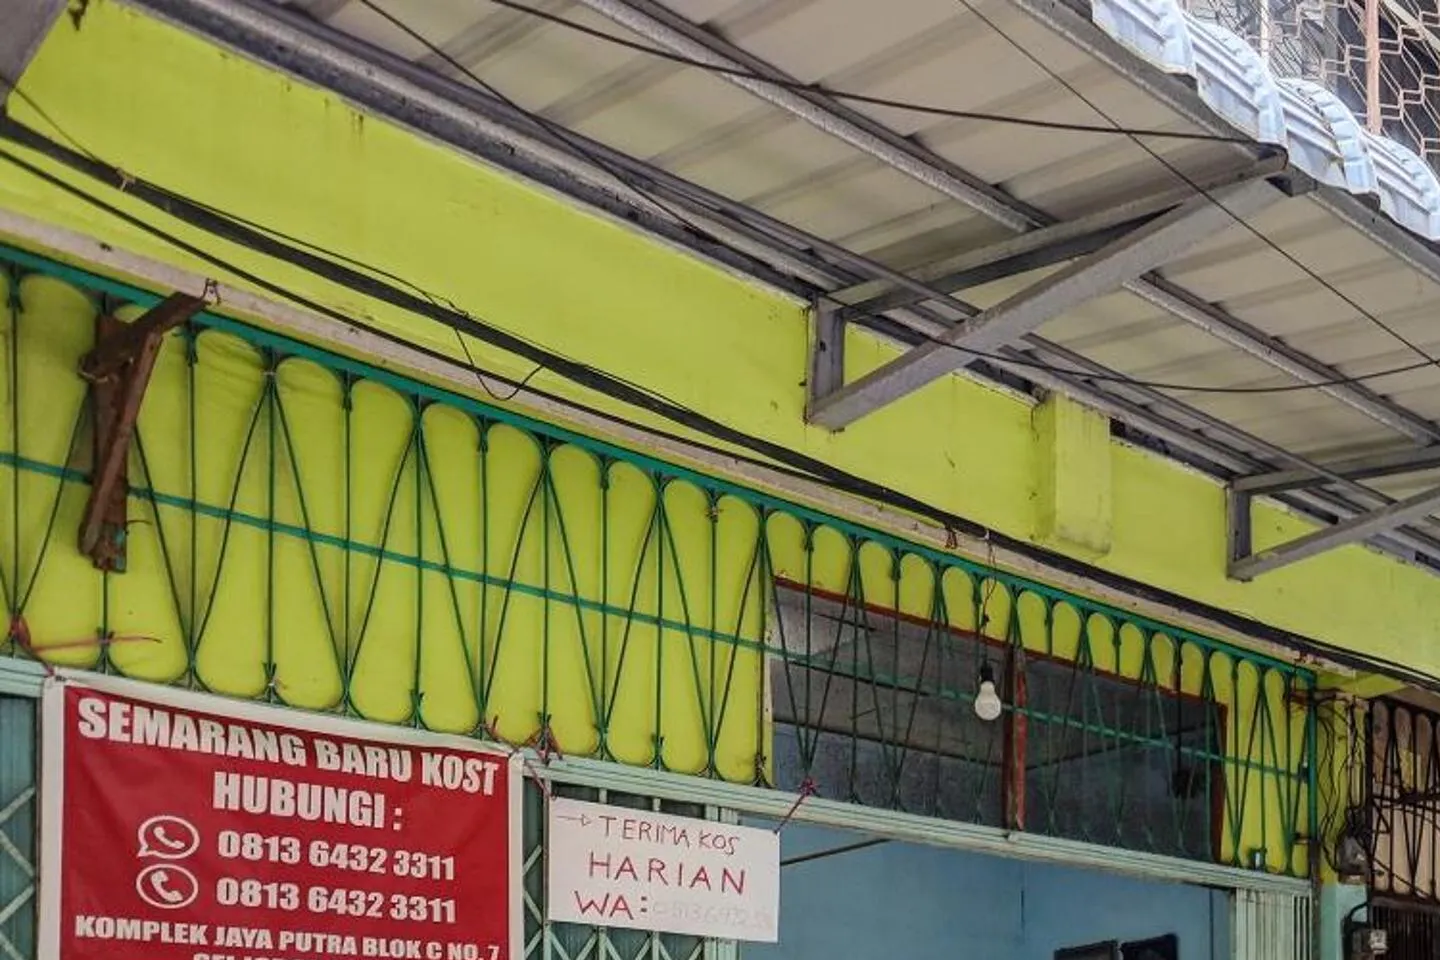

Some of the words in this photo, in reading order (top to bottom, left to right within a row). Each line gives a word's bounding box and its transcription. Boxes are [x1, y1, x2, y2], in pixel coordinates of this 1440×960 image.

[78, 698, 306, 767] SEMARANG
[314, 739, 412, 783] BARU
[421, 752, 499, 796] KOST
[213, 771, 385, 829] HUBUNGI
[218, 830, 300, 864] 0813
[308, 840, 388, 874] 6432
[393, 850, 455, 881] 3311
[598, 815, 691, 848] TERIMA
[698, 830, 741, 856] KOS
[588, 851, 745, 895] HARIAN
[216, 877, 299, 911] 0813
[308, 886, 382, 918] 6432
[390, 894, 456, 924] 3311
[573, 890, 648, 921] WA:
[75, 915, 208, 945] KOMPLEK
[214, 927, 273, 950] JAYA
[278, 931, 357, 956] PUTRA
[361, 938, 422, 960] BLOK
[426, 942, 443, 960] C
